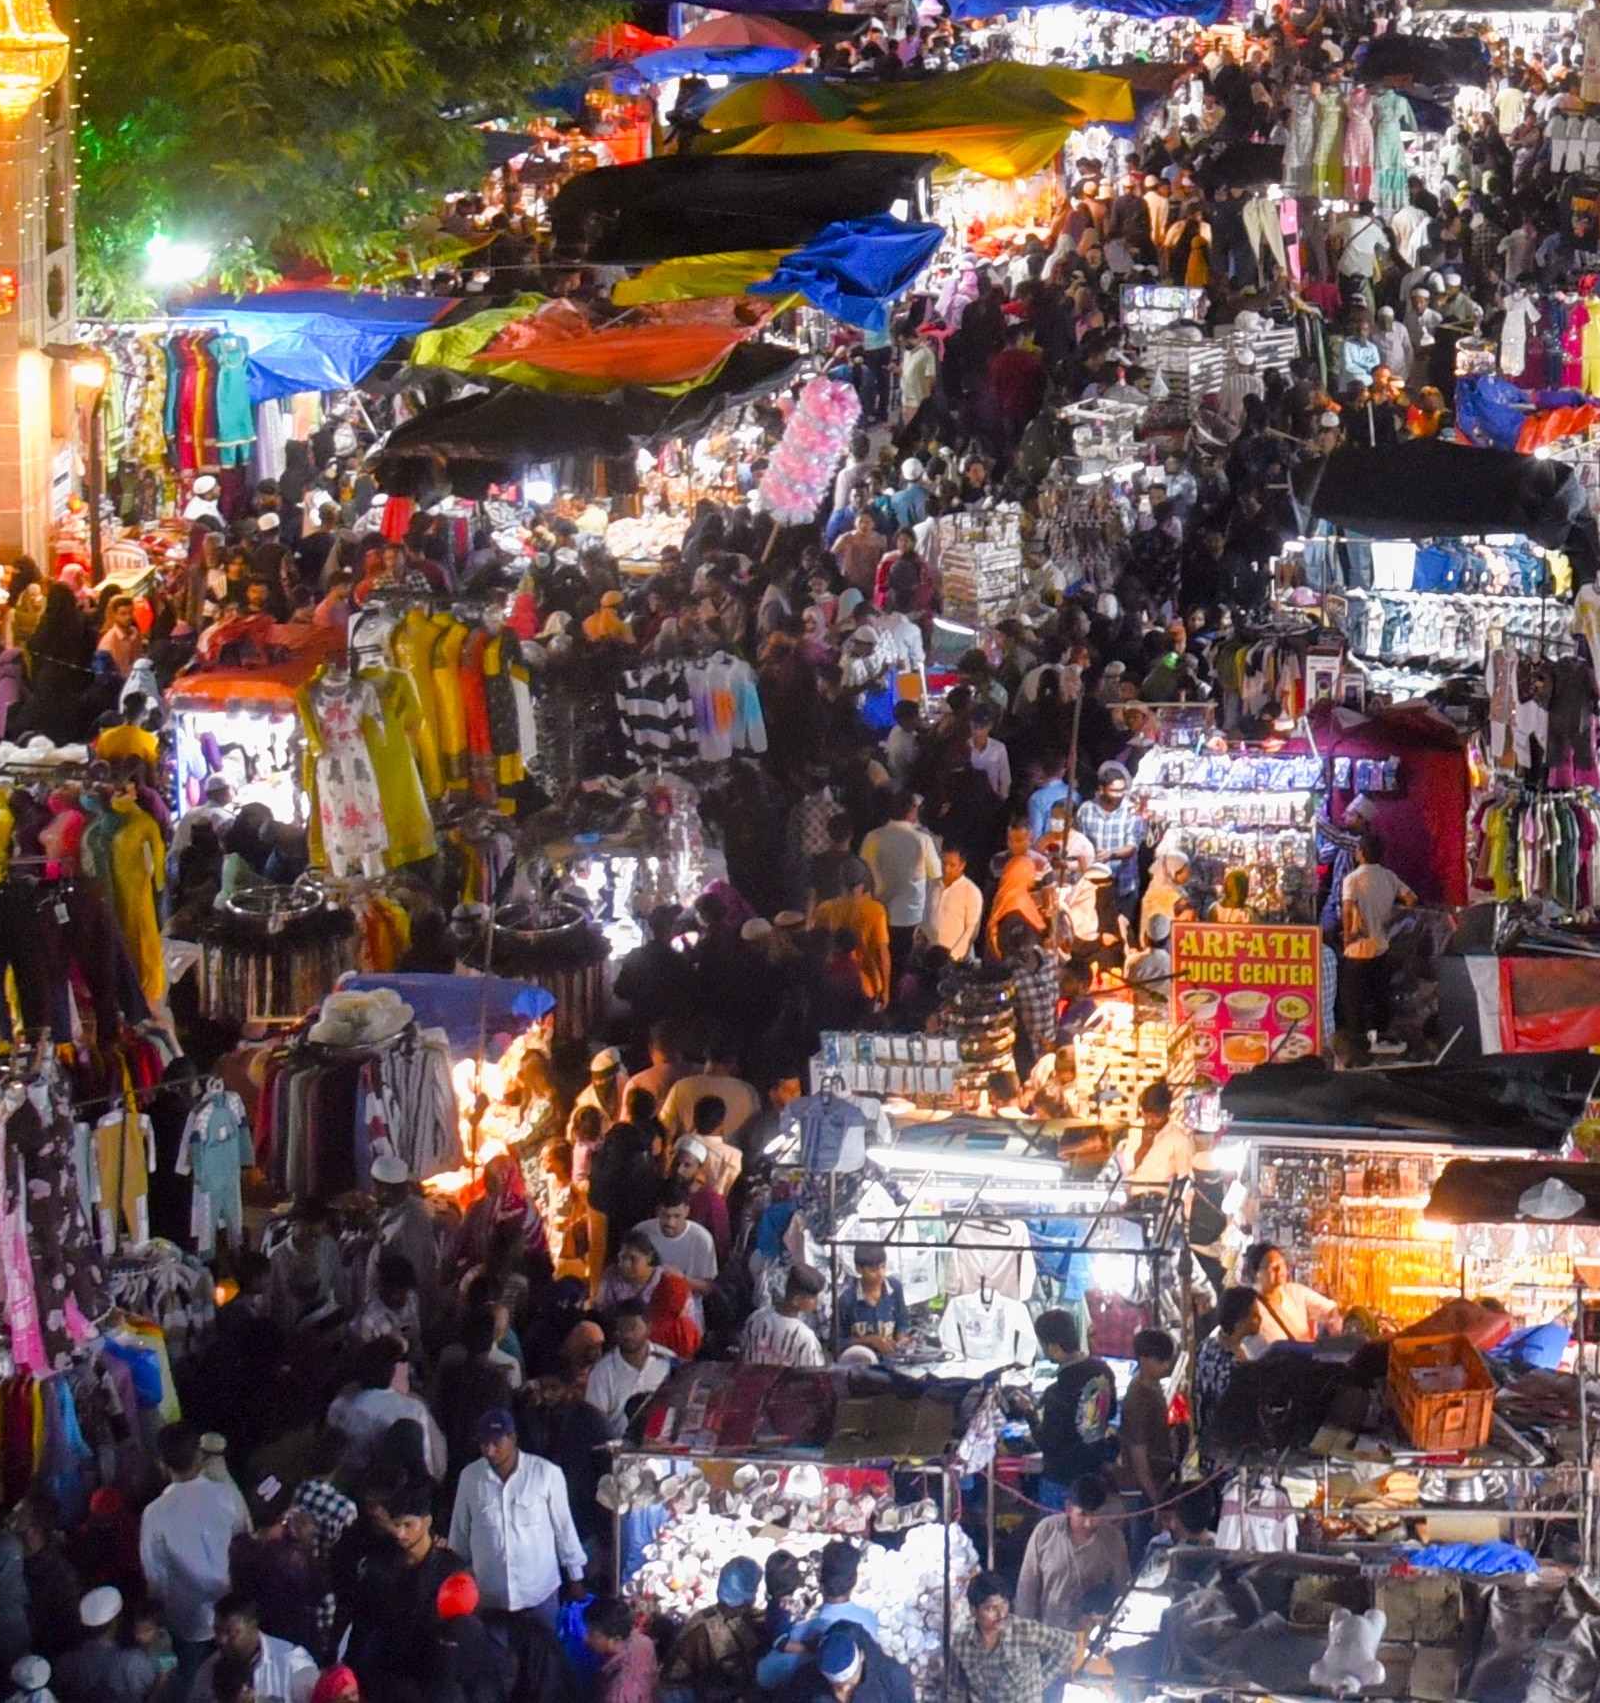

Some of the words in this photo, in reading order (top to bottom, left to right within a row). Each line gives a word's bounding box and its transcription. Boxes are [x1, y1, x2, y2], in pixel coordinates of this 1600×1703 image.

[1178, 929, 1312, 959] ARFATH
[1178, 960, 1234, 983] JUICE
[1239, 962, 1314, 986] CENTER
